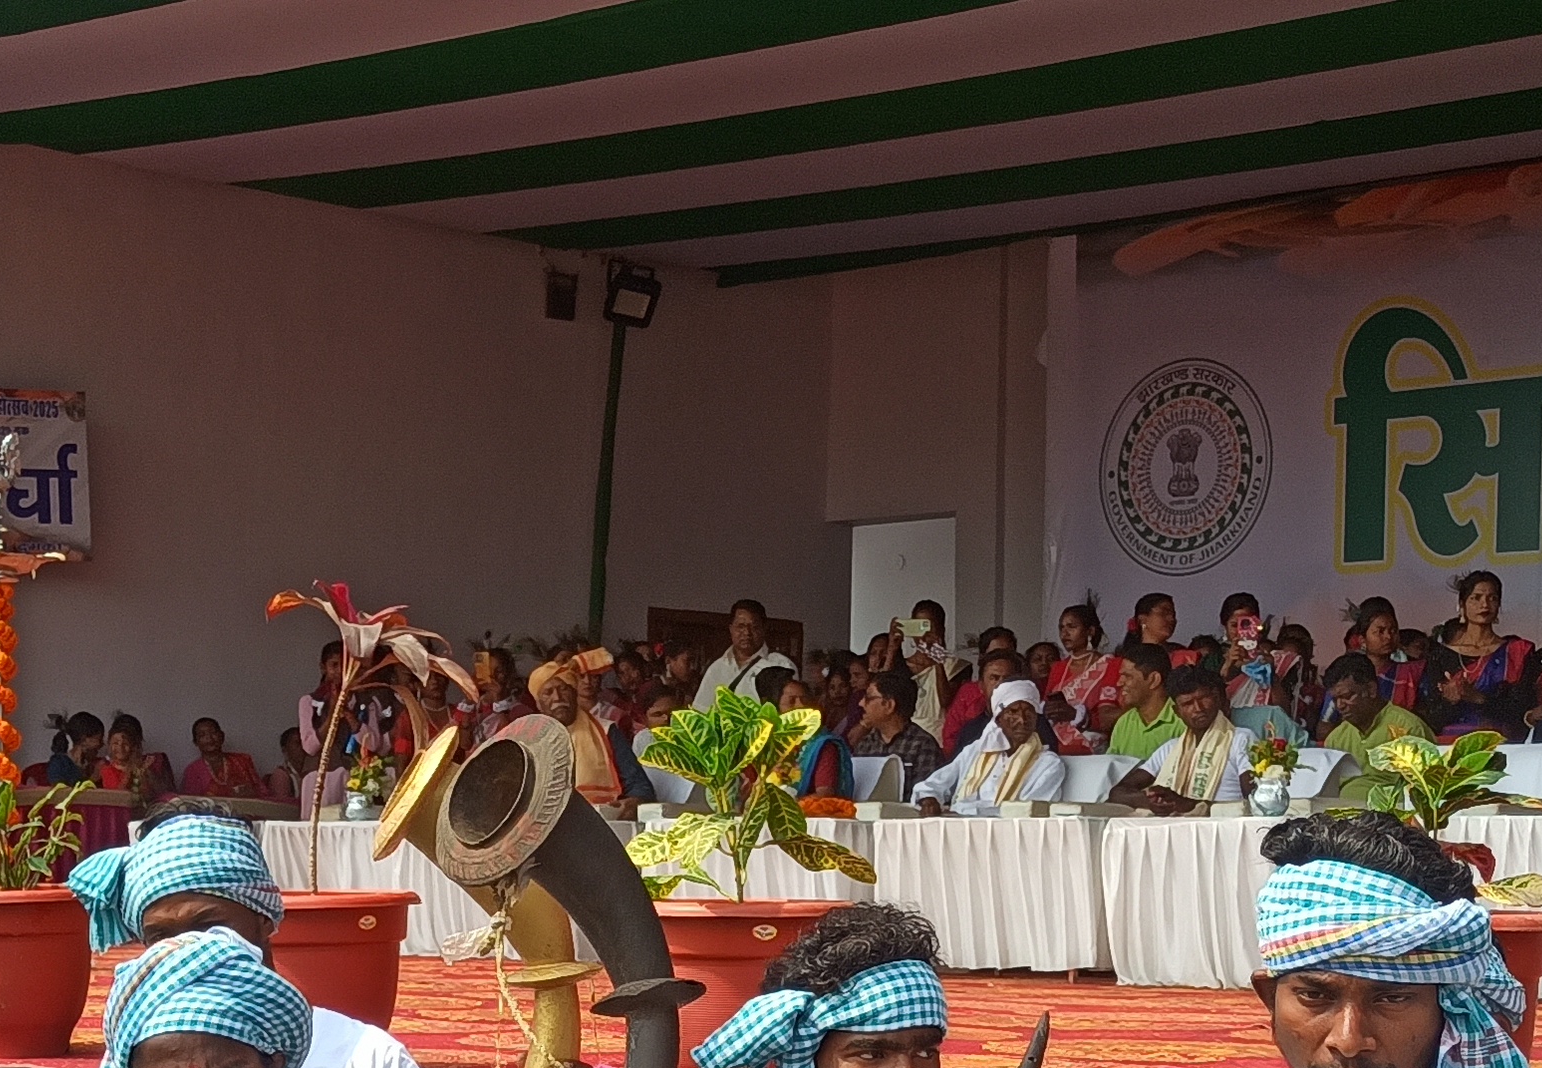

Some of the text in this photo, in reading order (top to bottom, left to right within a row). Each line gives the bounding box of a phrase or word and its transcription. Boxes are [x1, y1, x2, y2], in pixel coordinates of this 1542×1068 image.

[1136, 367, 1237, 404] झारखण्ड सरकार
[33, 400, 60, 419] 2025
[1109, 477, 1262, 566] GOVERNMENT OF JHARKHAND
